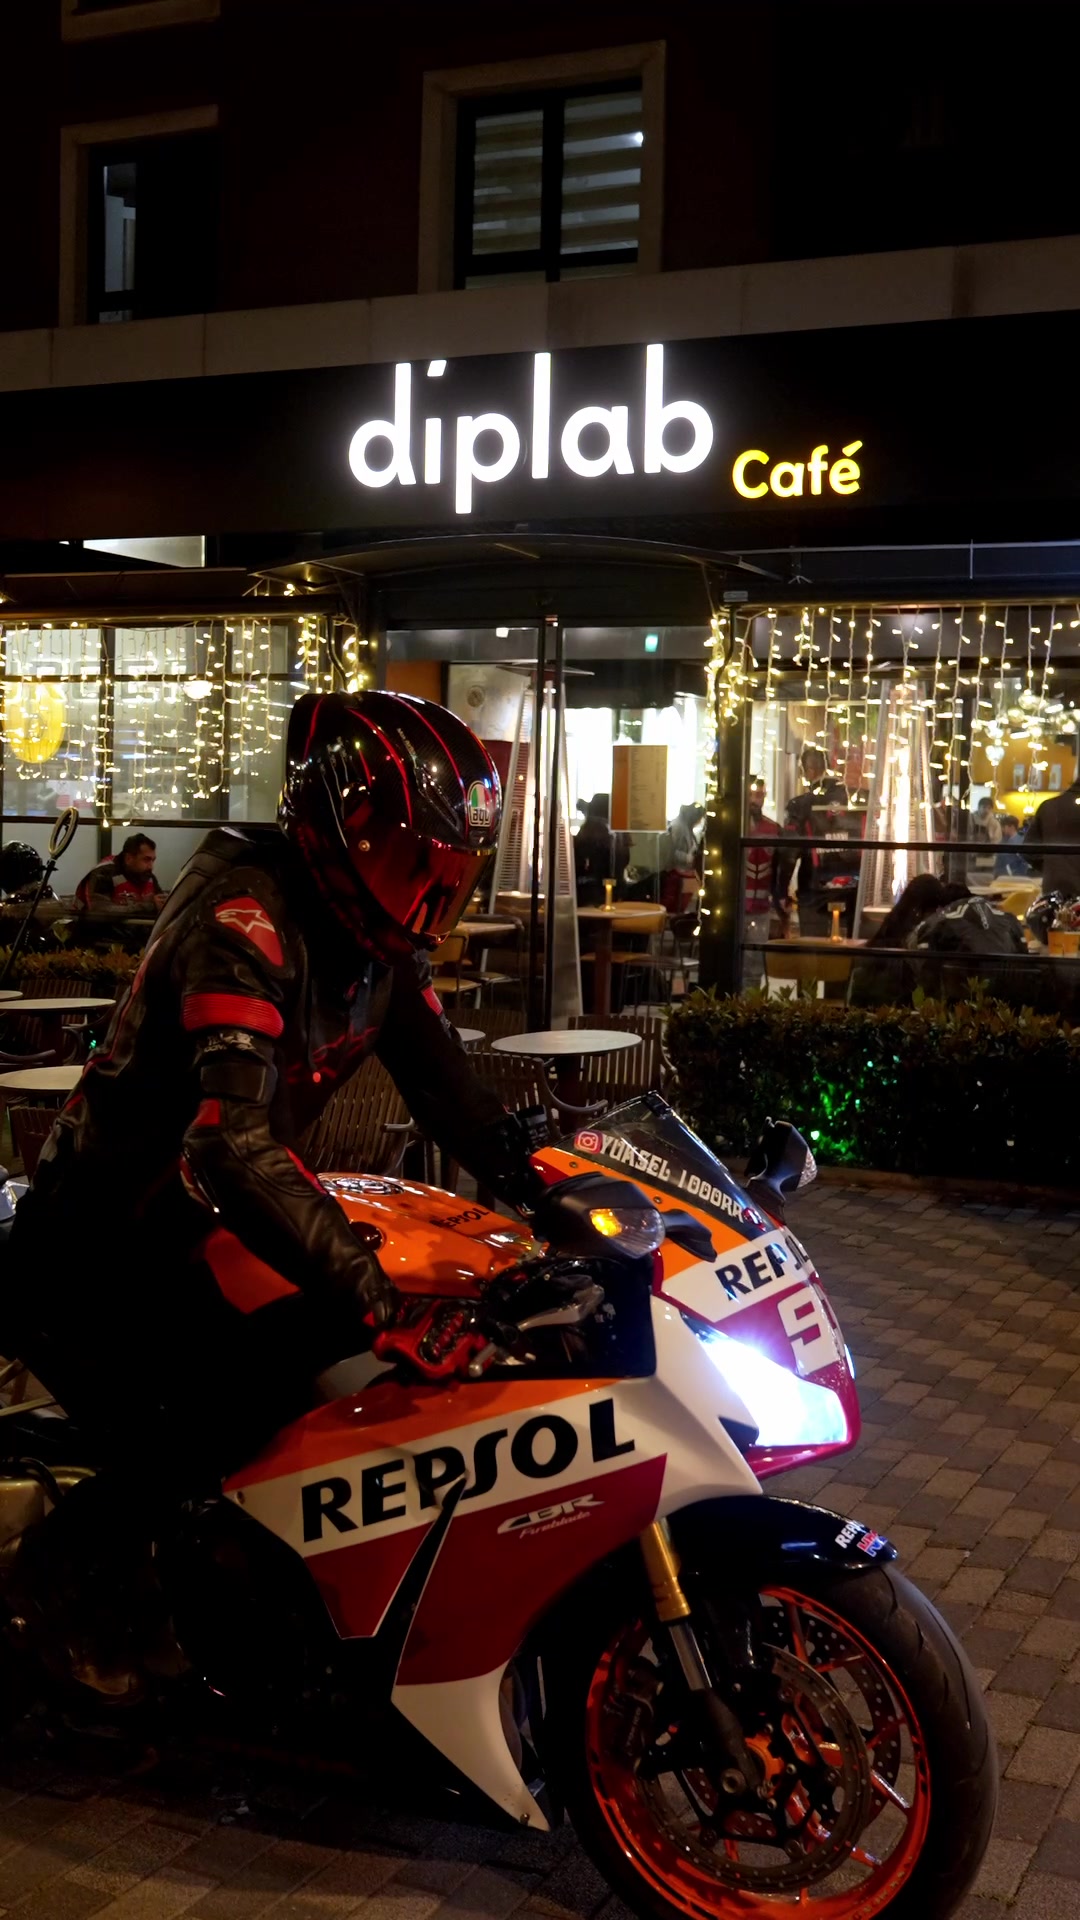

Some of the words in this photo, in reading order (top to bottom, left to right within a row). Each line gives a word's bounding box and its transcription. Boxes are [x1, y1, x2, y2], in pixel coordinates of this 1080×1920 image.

[349, 343, 714, 514] diplab
[732, 440, 862, 499] Café
[302, 1397, 636, 1543] REPSOL
[496, 1493, 606, 1535] CBR
